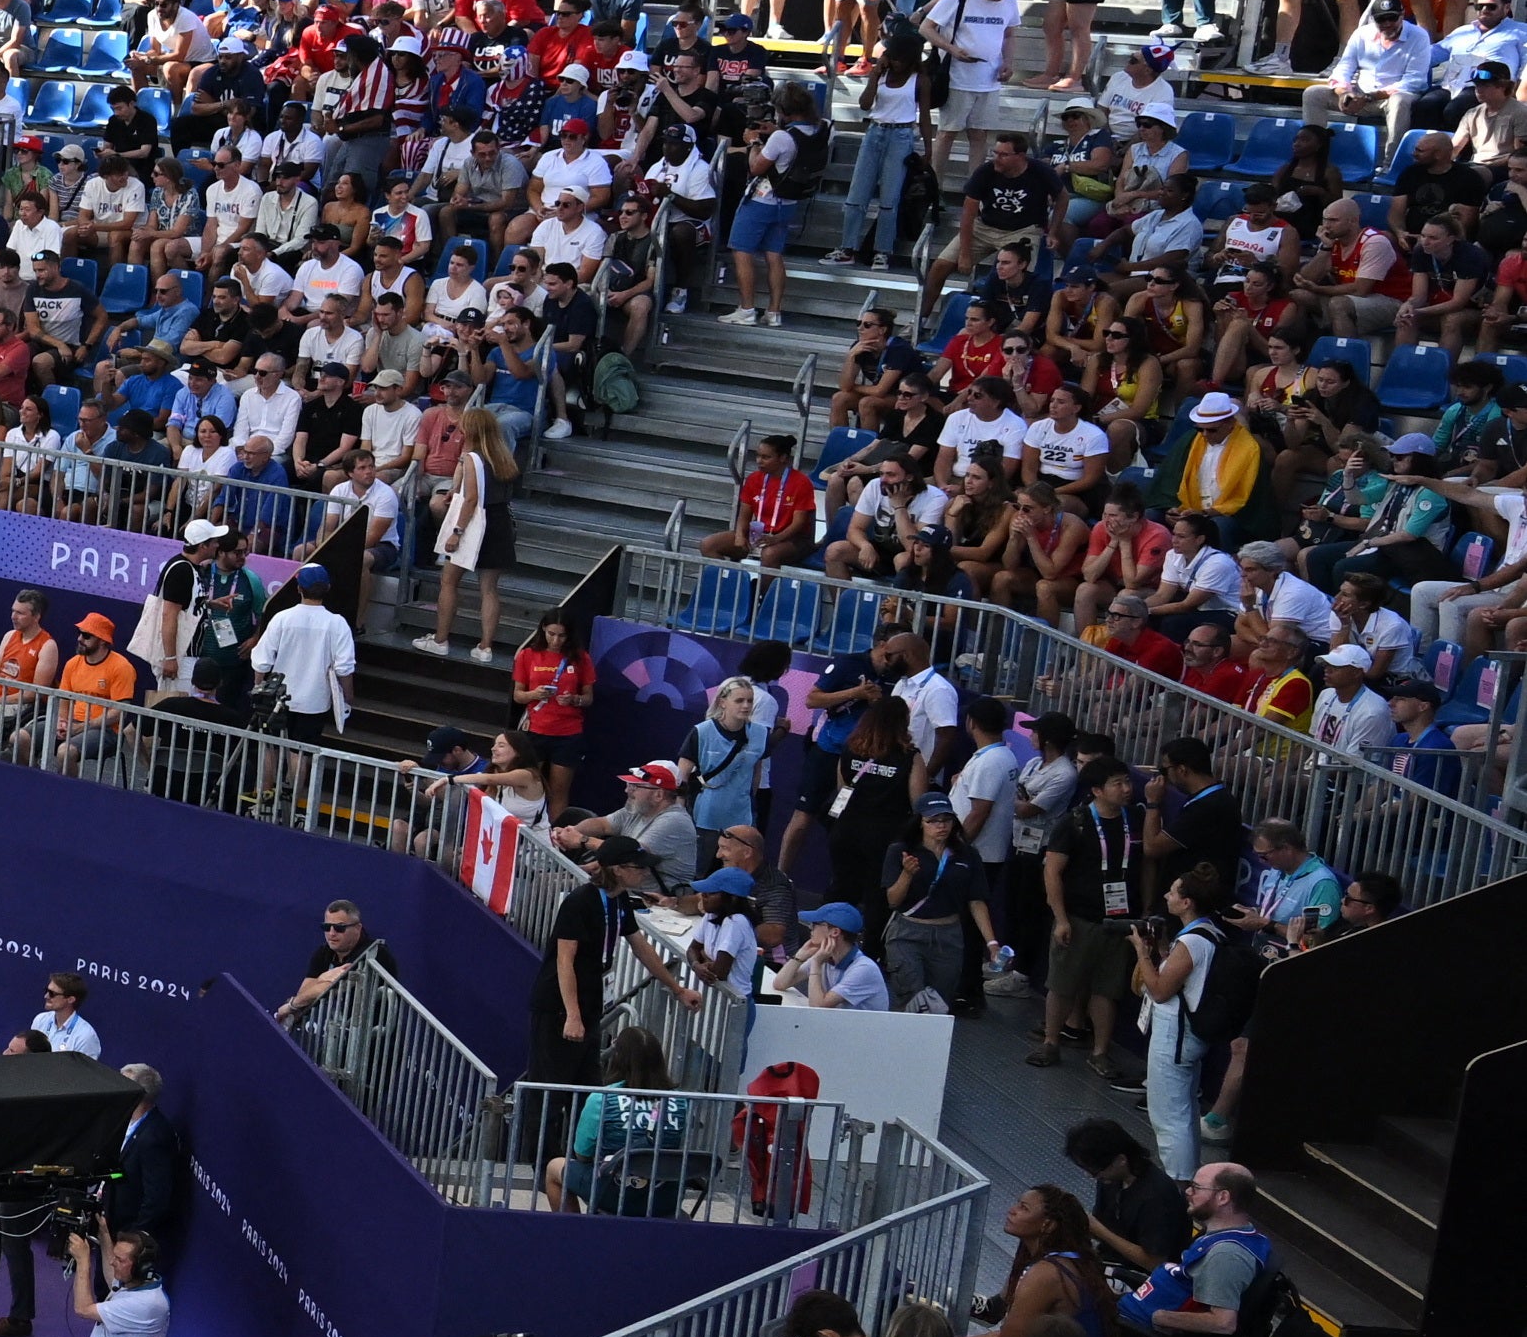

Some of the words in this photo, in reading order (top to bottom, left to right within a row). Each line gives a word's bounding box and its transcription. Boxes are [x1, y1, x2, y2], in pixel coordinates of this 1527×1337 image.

[717, 57, 750, 75] USA
[596, 69, 619, 84] USA
[214, 202, 240, 215] FRANCE
[1227, 237, 1265, 254] ESPAÑA
[34, 299, 63, 311] JACK
[1041, 443, 1074, 454] JUANA
[1043, 450, 1067, 462] 22
[76, 958, 130, 985] PARIS
[137, 974, 189, 1001] 2024
[241, 1218, 267, 1258] PARIS
[267, 1248, 288, 1284] 2024
[298, 1287, 325, 1330] PARIS
